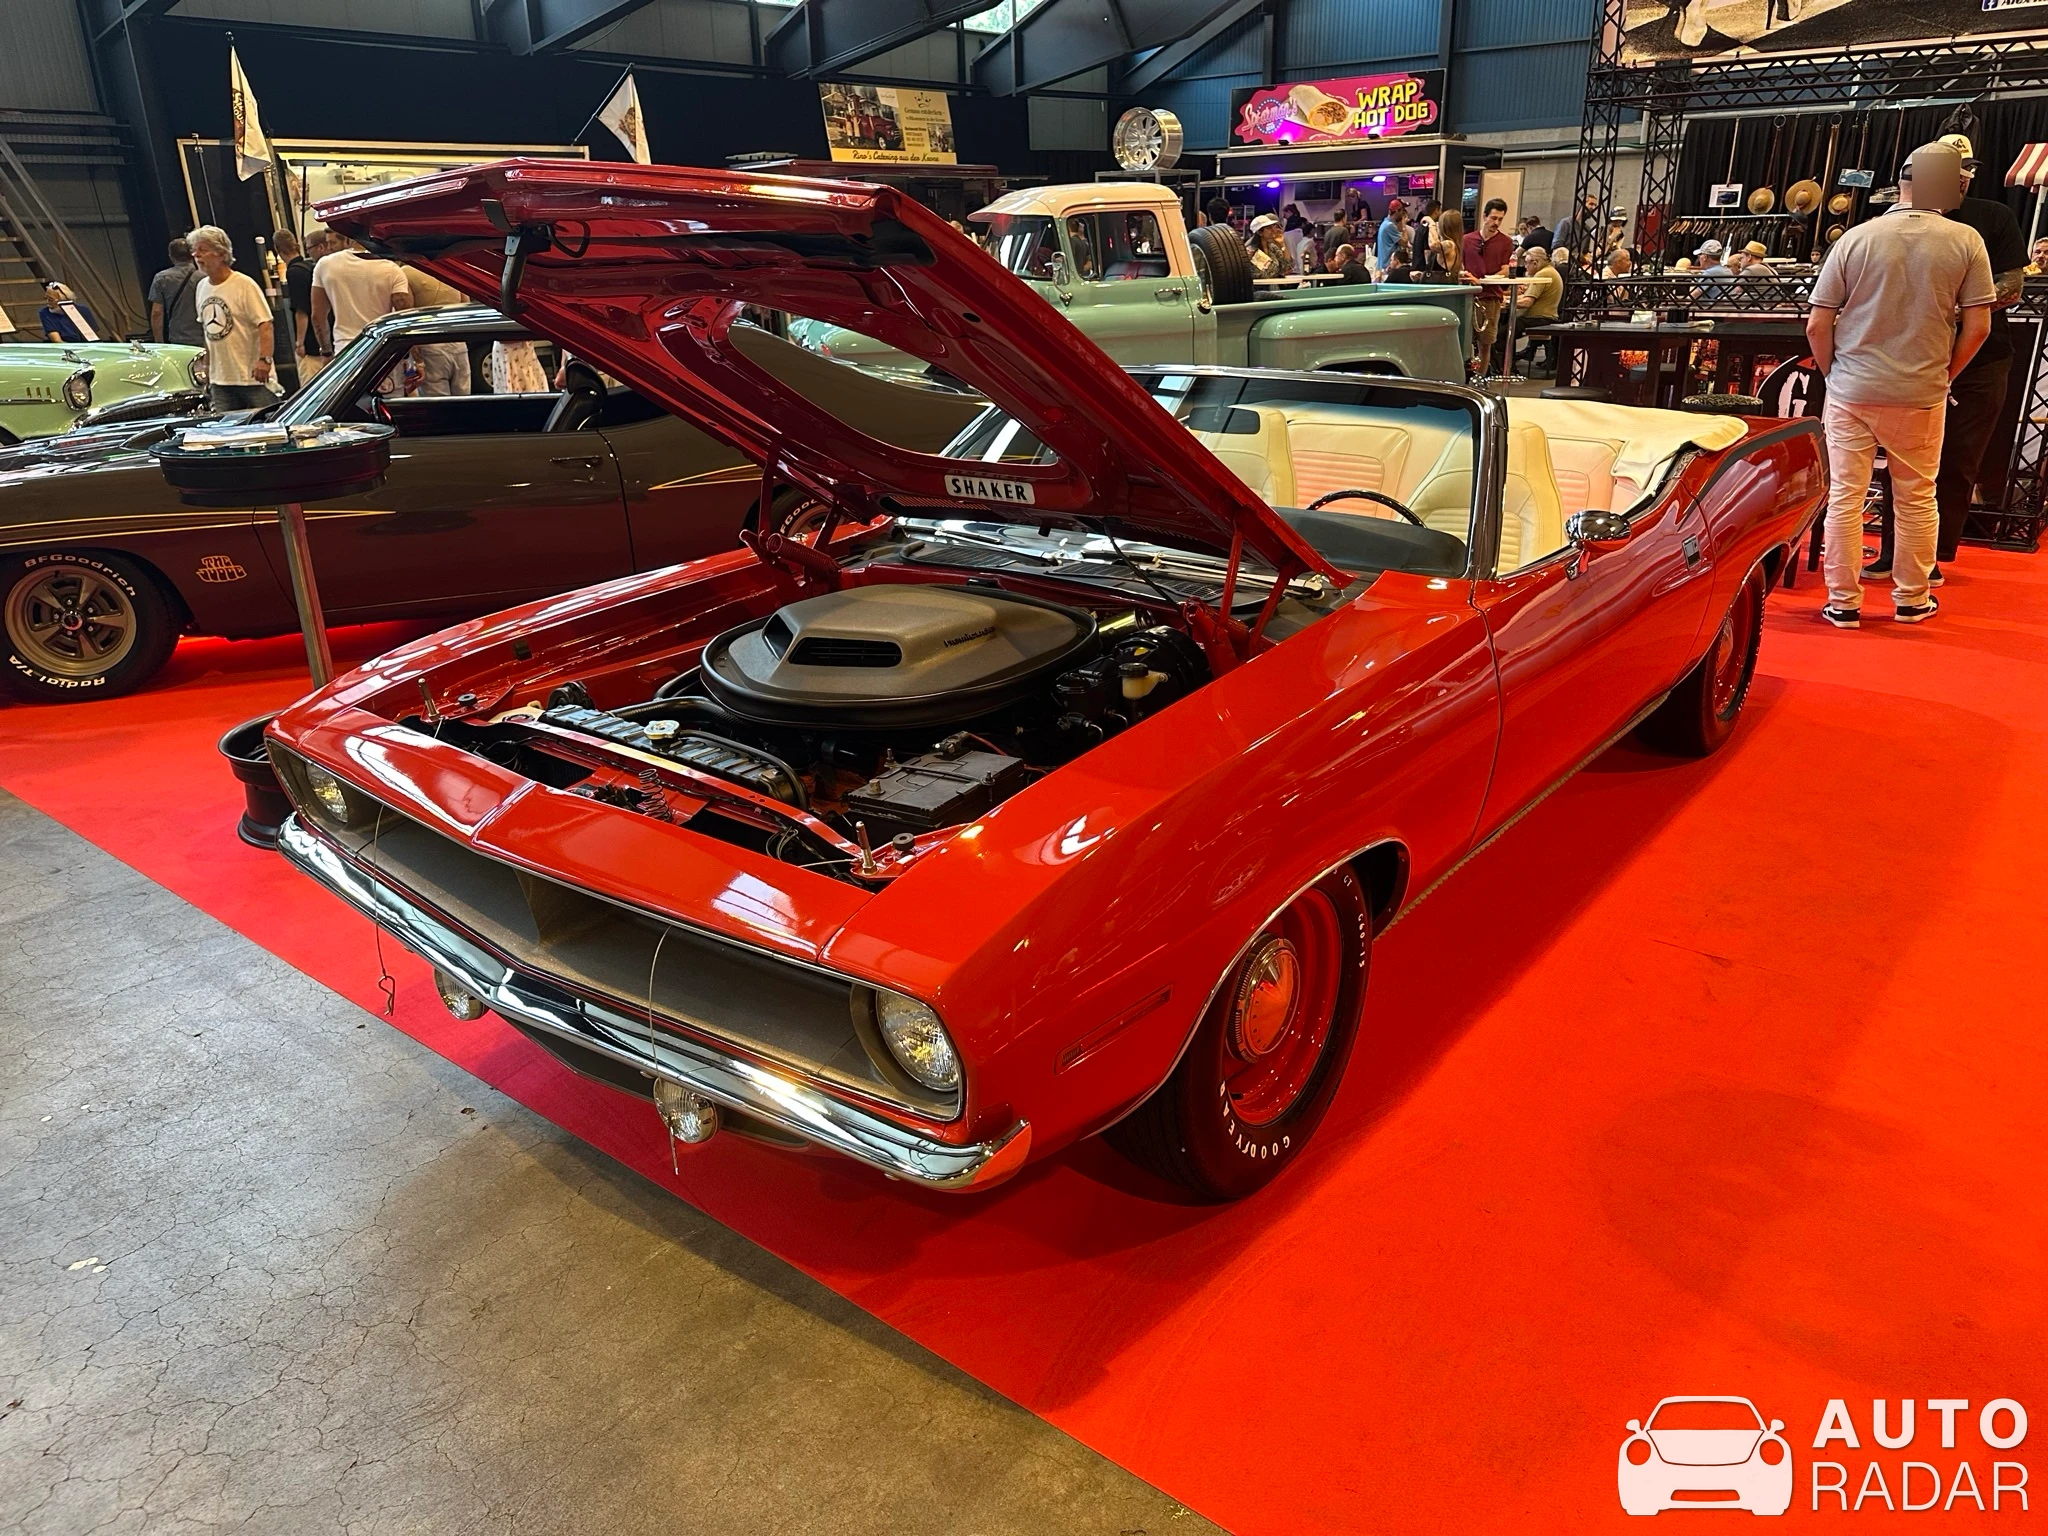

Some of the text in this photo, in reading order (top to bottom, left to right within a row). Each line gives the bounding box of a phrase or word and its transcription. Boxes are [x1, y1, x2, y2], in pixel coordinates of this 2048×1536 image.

[1358, 81, 1418, 110] WRAP
[1353, 102, 1429, 129] HOT DOG
[951, 478, 1028, 501] SHAKER
[24, 554, 136, 597] BFGoodrich
[196, 565, 248, 583] JUDGE
[201, 556, 233, 568] THE
[8, 654, 106, 689] Radial T/A
